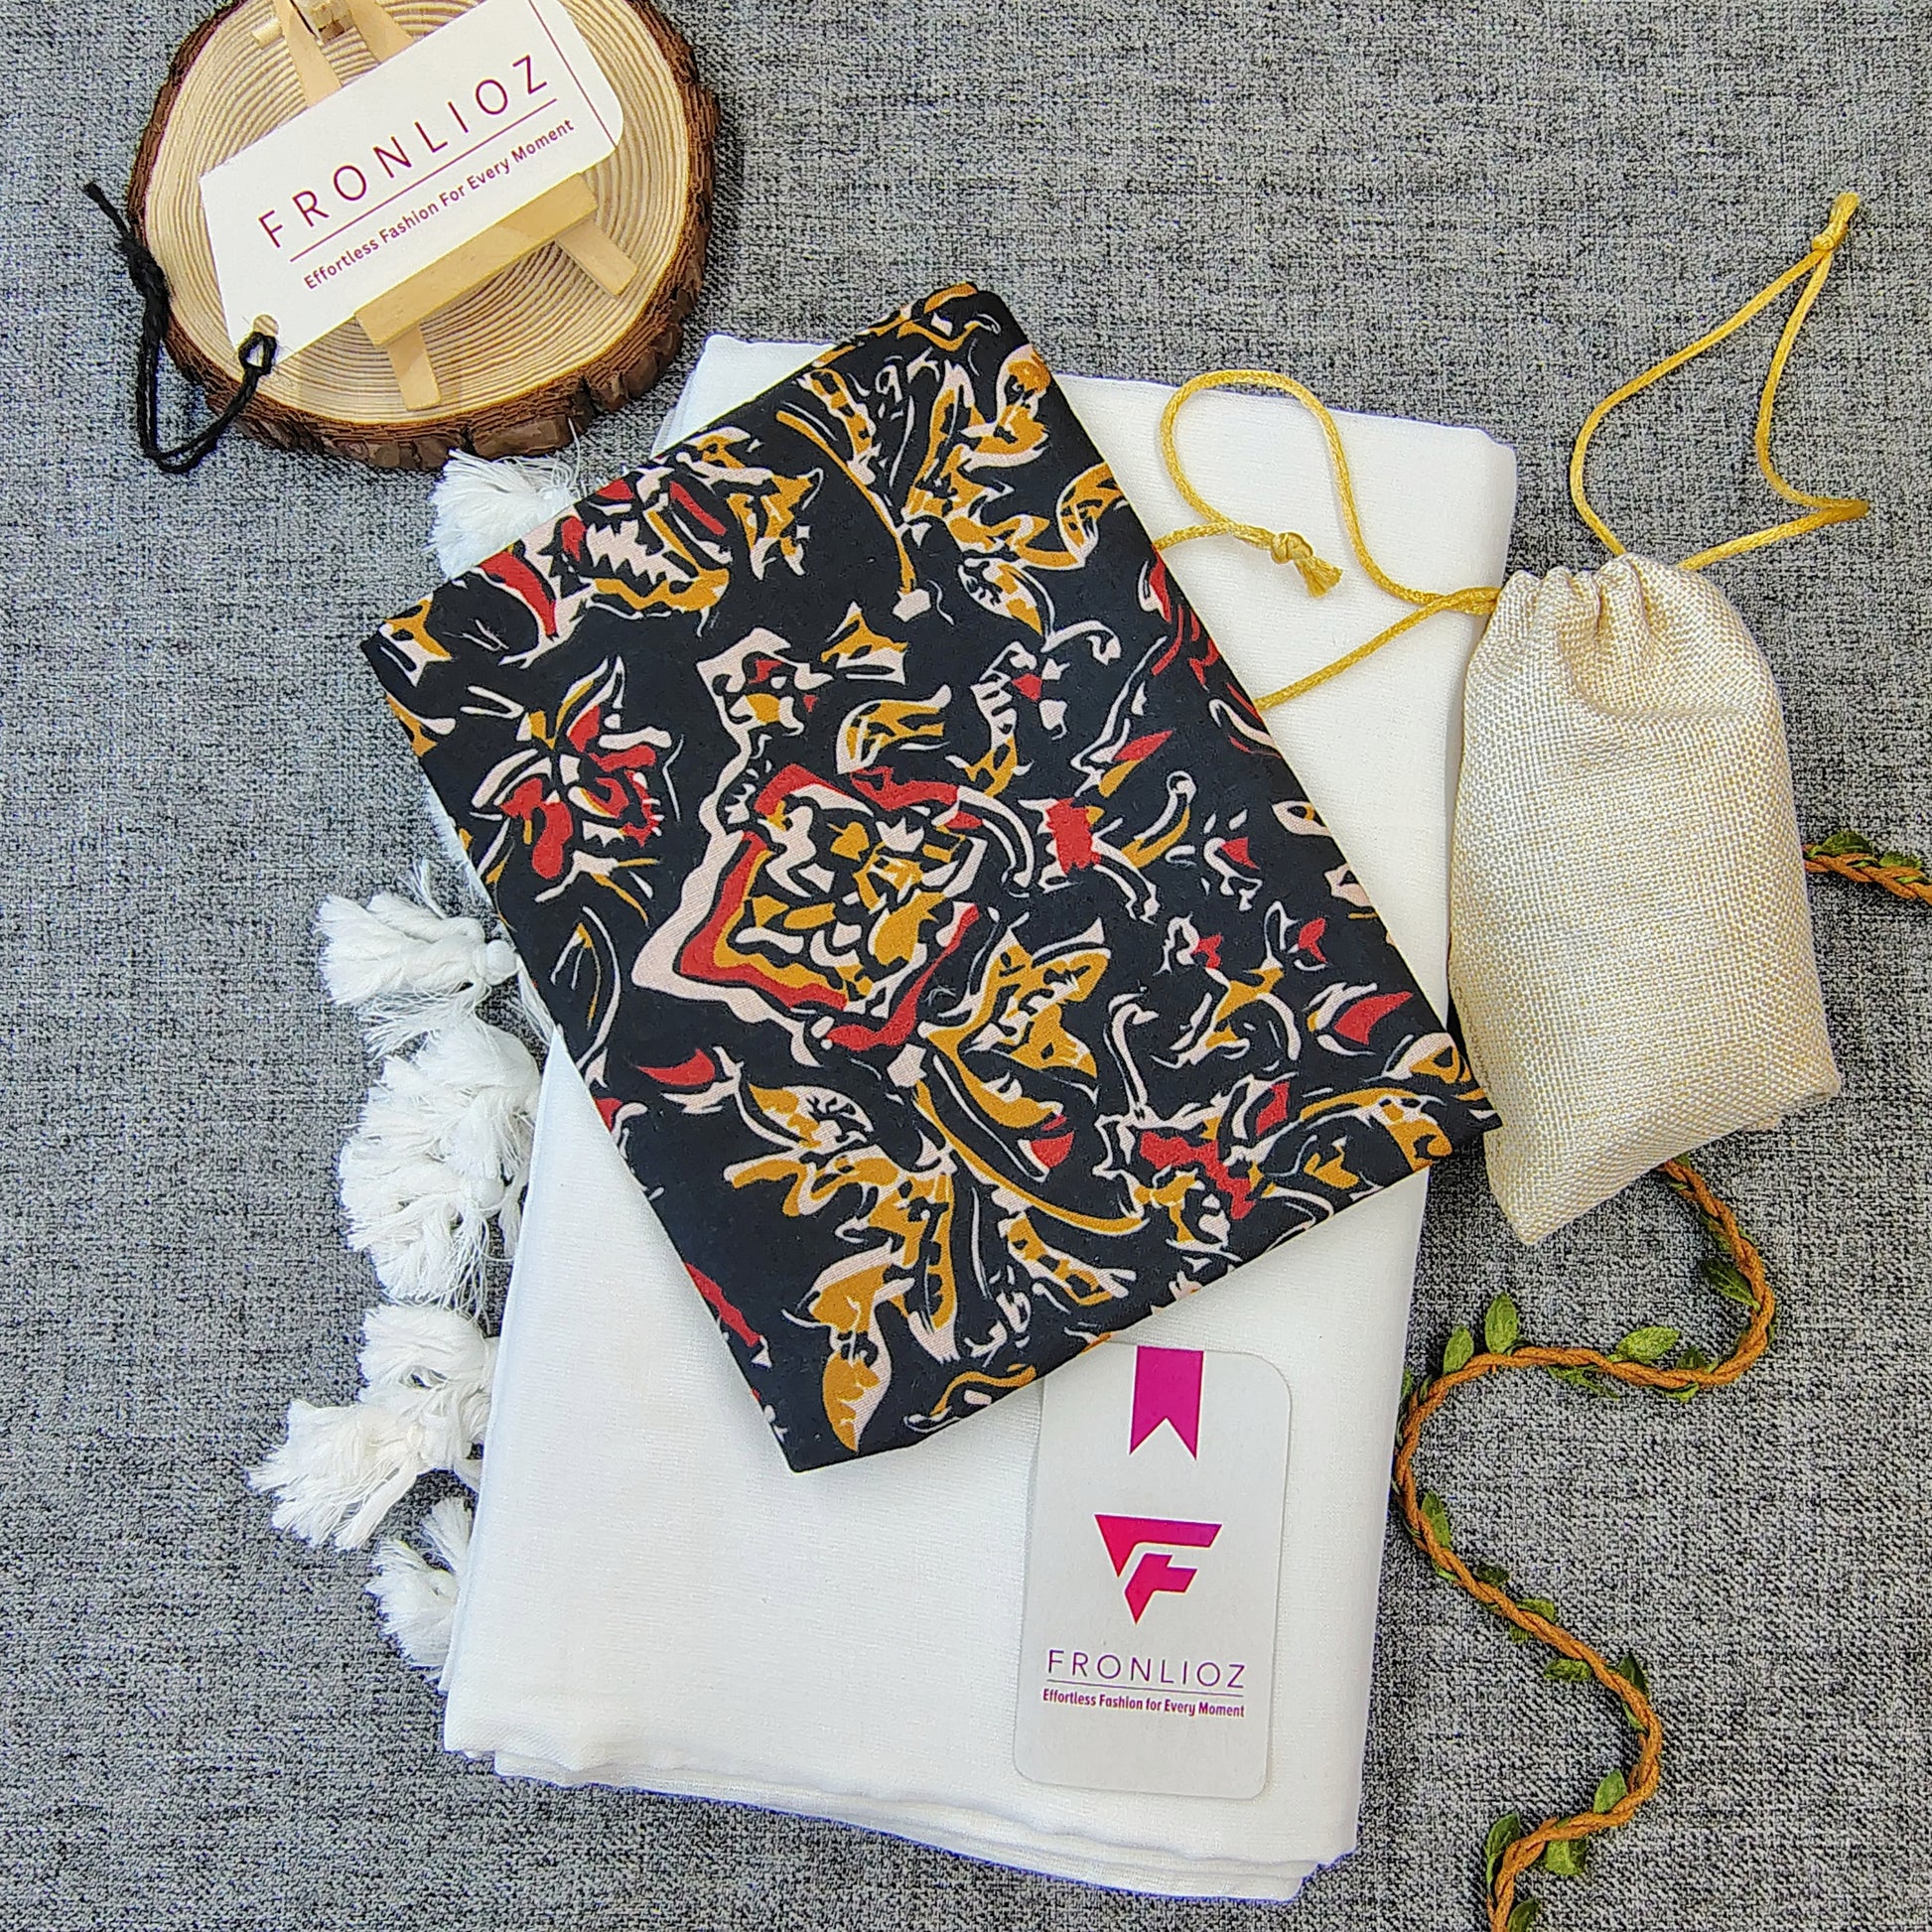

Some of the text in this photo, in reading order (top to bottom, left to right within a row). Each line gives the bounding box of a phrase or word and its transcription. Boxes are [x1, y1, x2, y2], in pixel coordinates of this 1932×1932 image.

[258, 54, 548, 248] FRONLIOZ
[304, 118, 575, 290] Effortless Fashion For Every Moment
[1042, 1688, 1245, 1718] Effortless Fashion for Every Moment
[1047, 1649, 1246, 1689] FRONLIOZ
